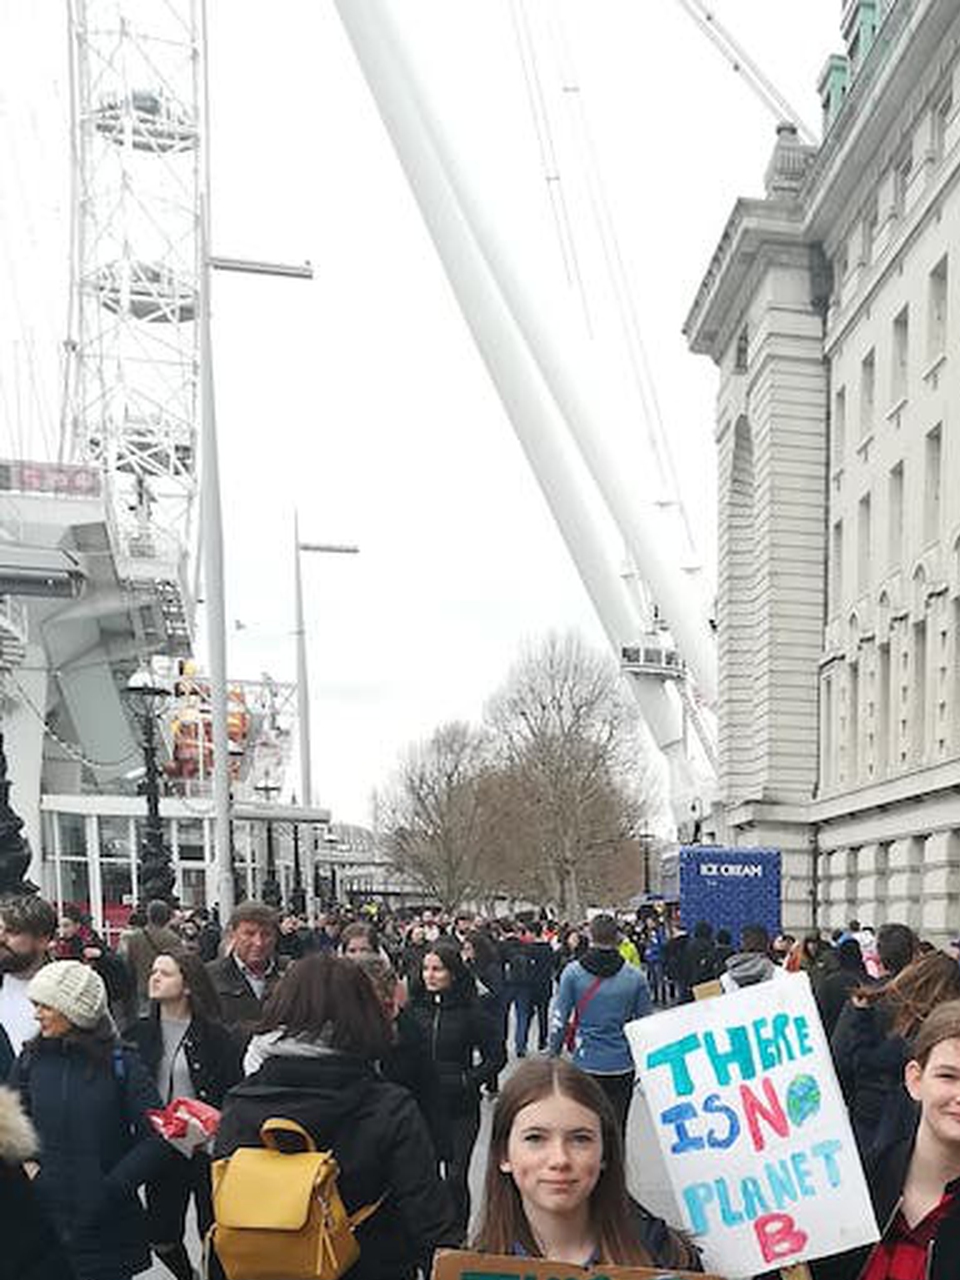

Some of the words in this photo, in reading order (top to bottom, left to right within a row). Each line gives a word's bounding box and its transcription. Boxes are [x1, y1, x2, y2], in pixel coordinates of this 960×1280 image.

[646, 1012, 814, 1097] THERE
[660, 1093, 742, 1155] IS
[681, 1138, 842, 1238] PLANET
[753, 1212, 808, 1265] B
